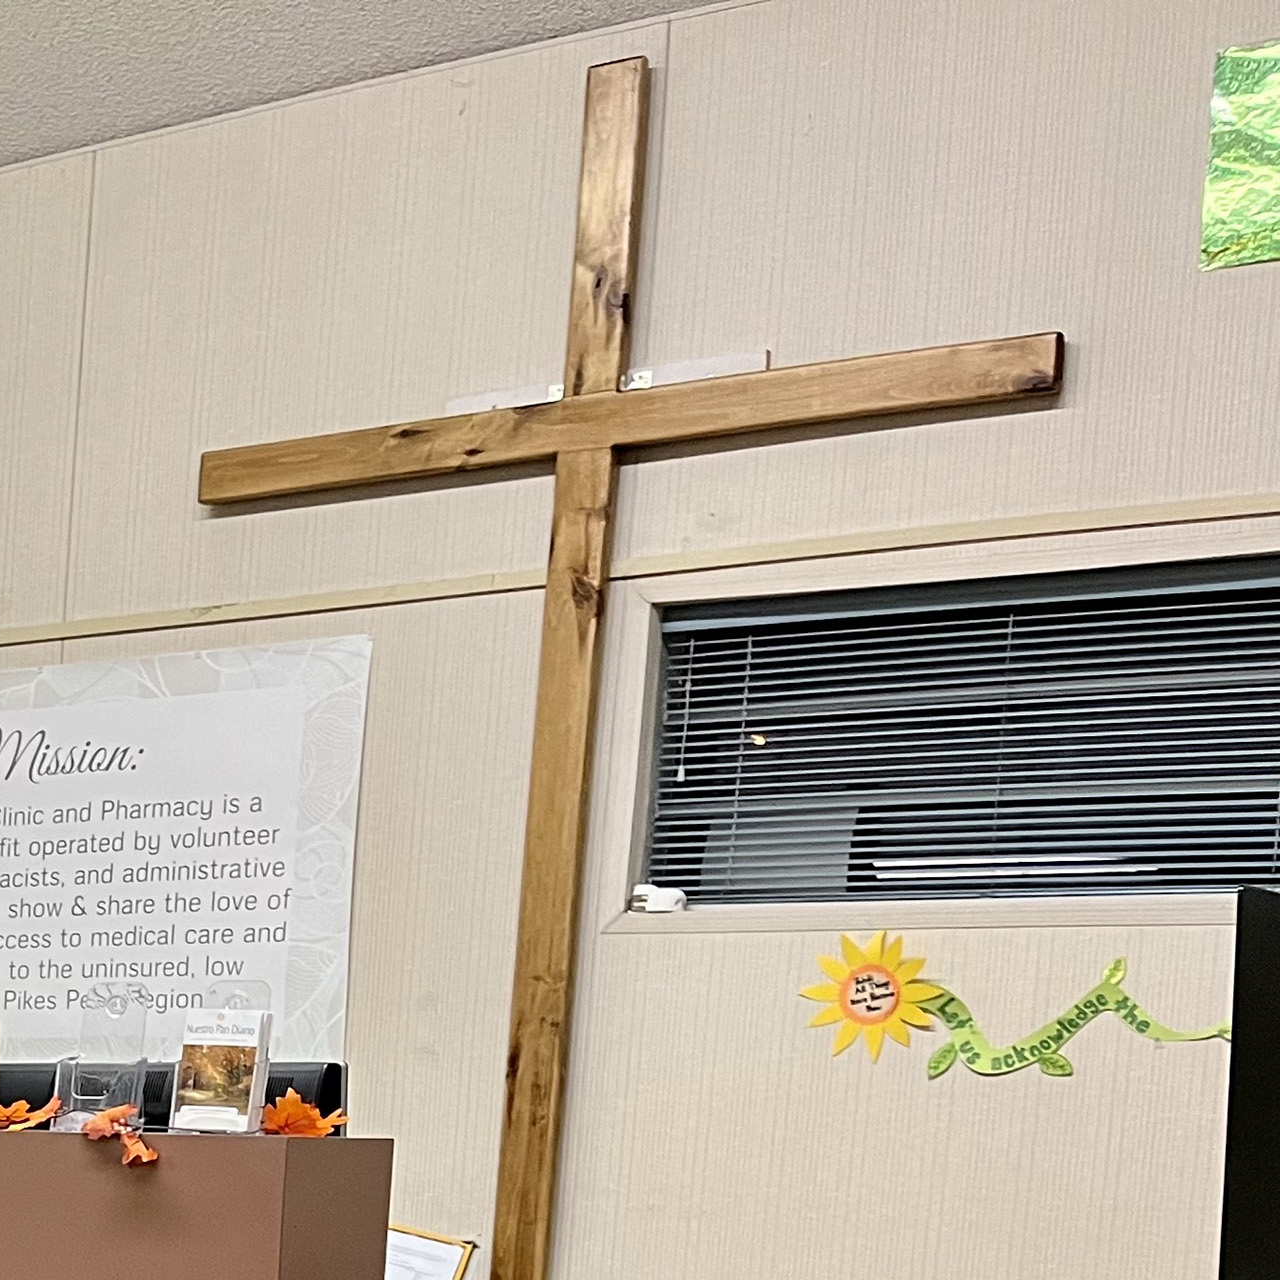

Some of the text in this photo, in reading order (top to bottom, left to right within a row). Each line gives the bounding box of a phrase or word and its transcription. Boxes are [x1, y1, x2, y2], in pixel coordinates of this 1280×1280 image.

[52, 801, 92, 824] and
[101, 798, 213, 821] Pharmacy
[222, 793, 240, 814] is
[249, 796, 263, 813] a
[28, 831, 125, 860] operated
[134, 829, 161, 855] by
[170, 826, 281, 850] volunteer
[73, 863, 114, 885] and
[122, 858, 286, 883] administrative
[7, 898, 63, 919] show
[71, 895, 88, 917] &
[96, 895, 155, 916] share
[165, 892, 202, 913] the
[211, 891, 258, 912] love
[267, 887, 293, 910] of
[60, 927, 82, 948] to
[90, 924, 176, 947] medical
[184, 927, 234, 945] care
[243, 921, 287, 943] and
[9, 962, 30, 980] to
[39, 959, 72, 979] the
[81, 956, 195, 980] uninsured,
[205, 955, 245, 976] low
[4, 989, 57, 1010] Pikes
[939, 997, 973, 1031] Let
[186, 1023, 256, 1036] Nuestro Pan Diario
[1113, 995, 1152, 1035] the
[990, 992, 1109, 1071] acknowledge
[958, 1040, 981, 1066] us
